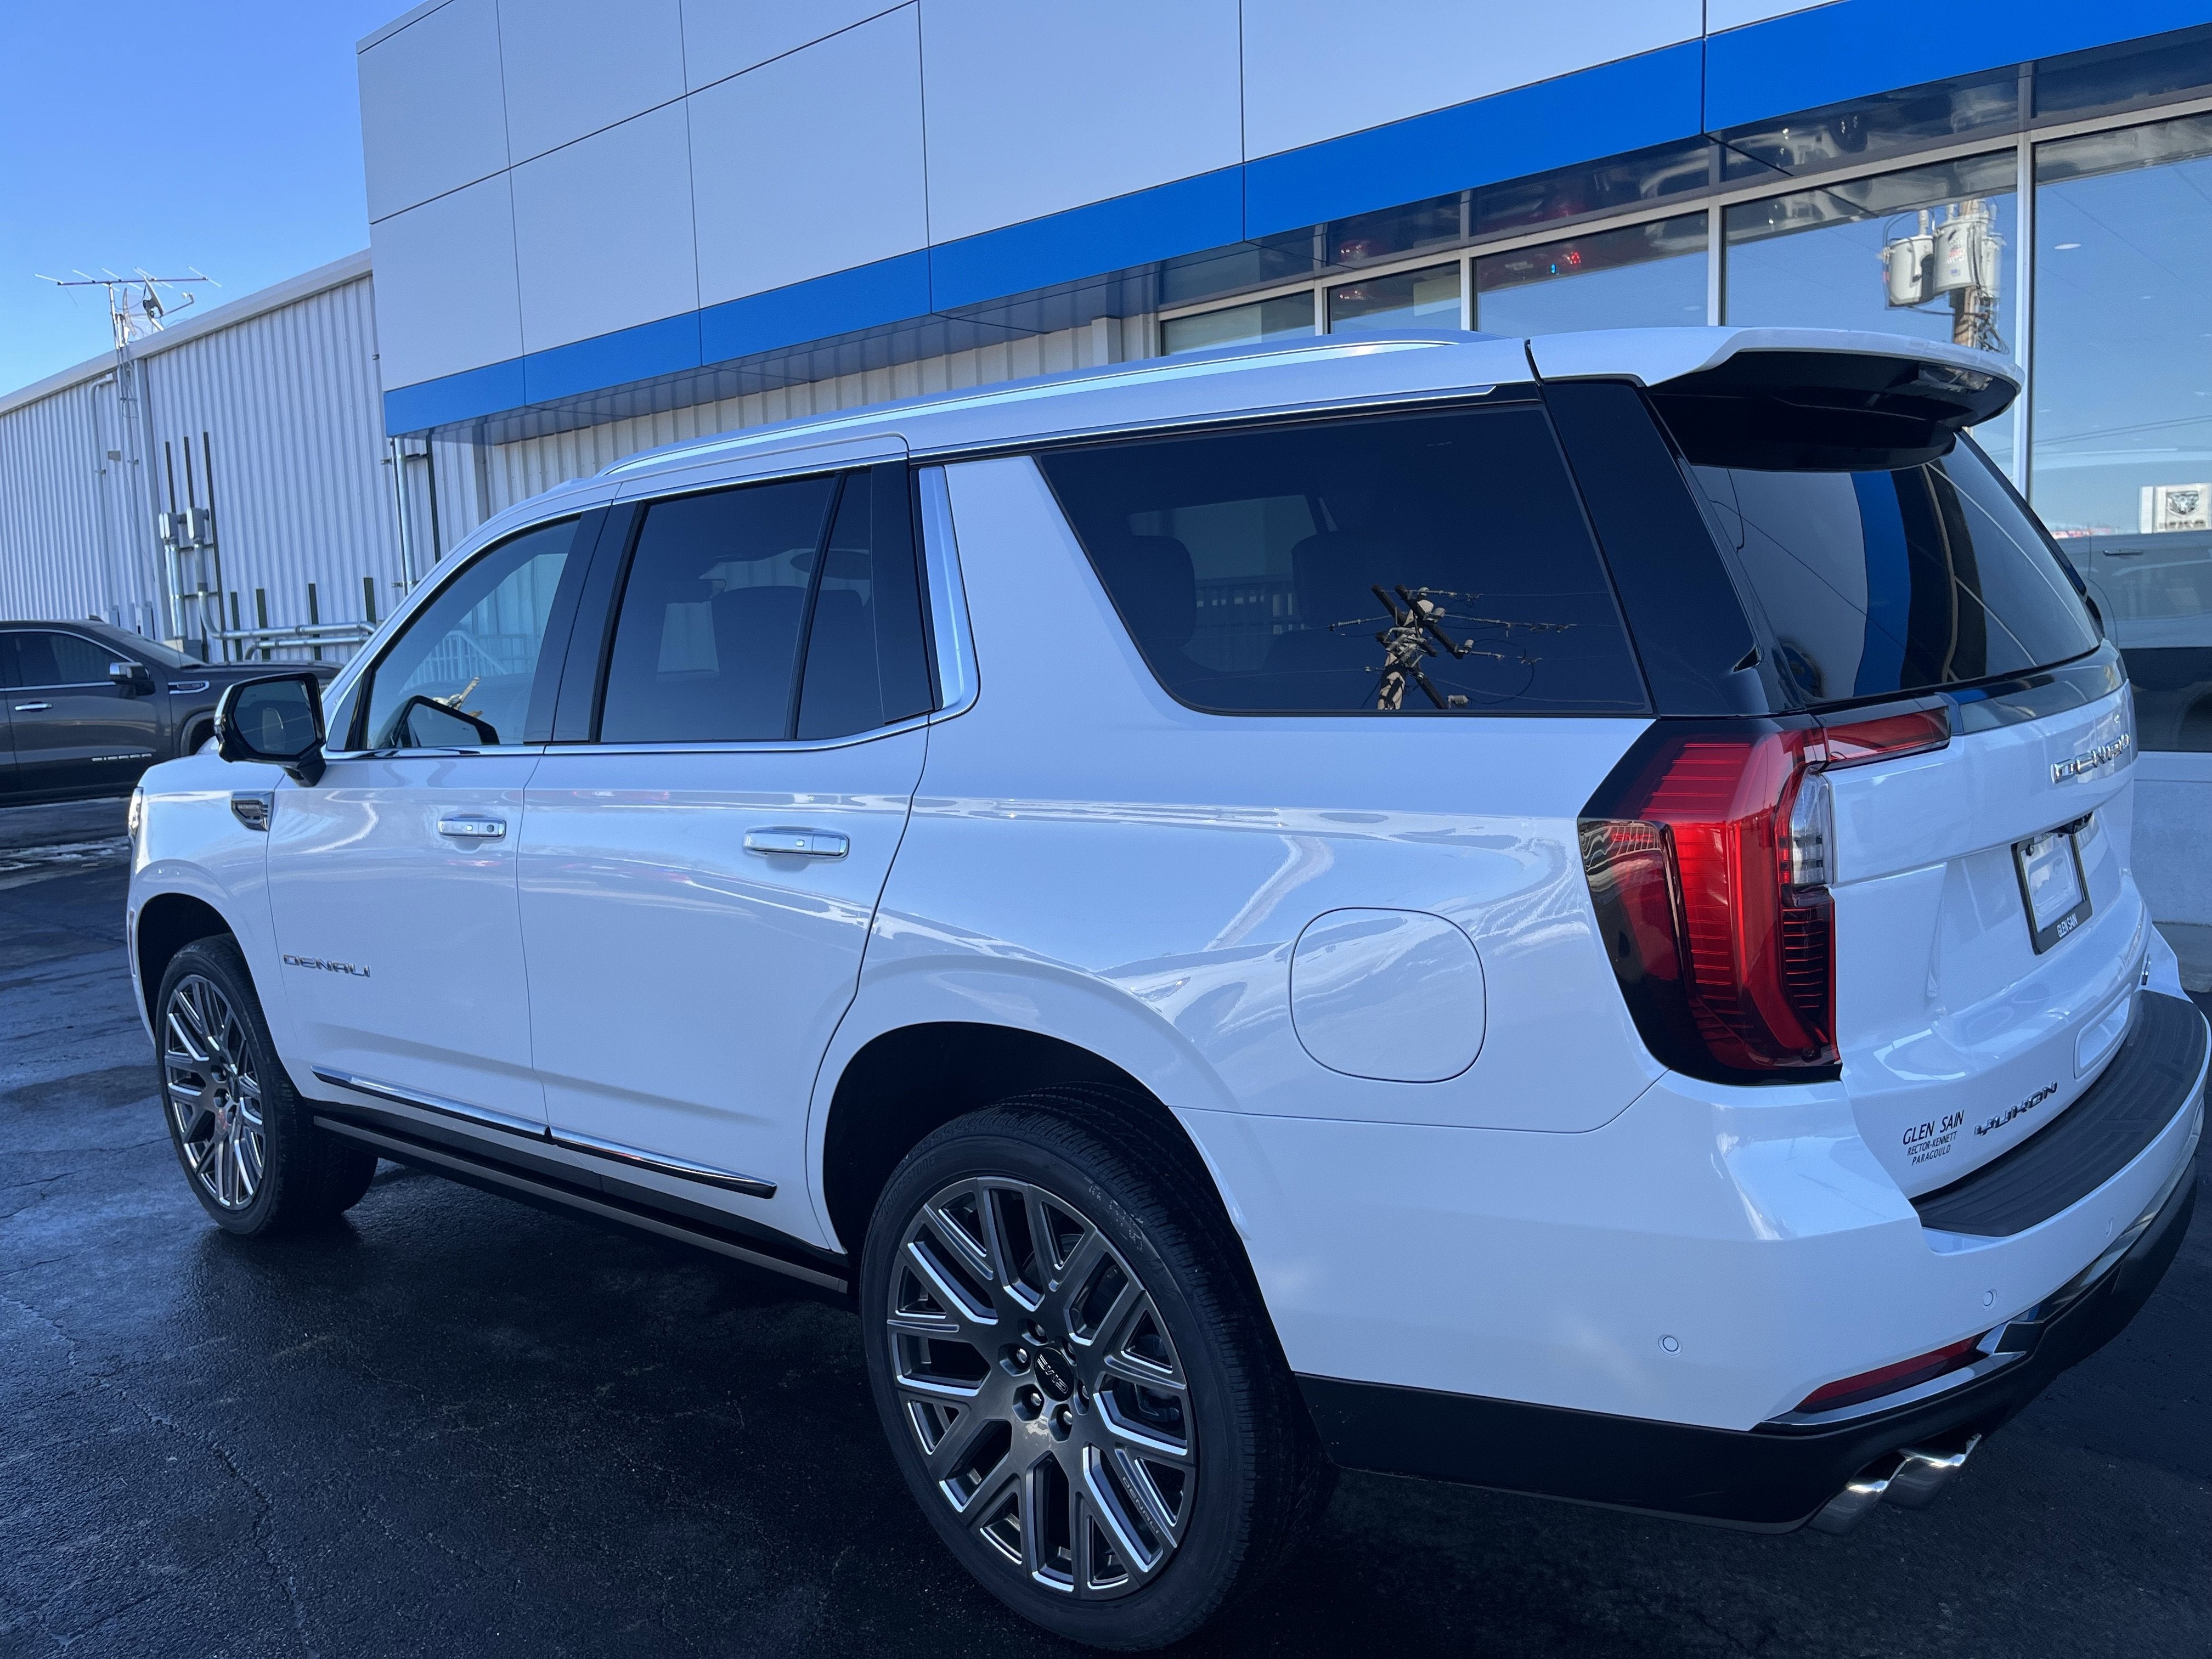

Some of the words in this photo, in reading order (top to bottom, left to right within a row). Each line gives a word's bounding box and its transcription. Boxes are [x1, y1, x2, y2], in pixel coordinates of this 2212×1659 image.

[1611, 833, 1654, 843] GMC
[283, 954, 370, 978] DENALI
[1974, 1080, 2058, 1136] YUKON
[1903, 1120, 1936, 1145] GLEN
[1939, 1109, 1965, 1133] SAIN
[1907, 1130, 1958, 1156] RECTOR-KENNETT
[1911, 1144, 1951, 1166] PARAGOULD
[1037, 1353, 1069, 1394] GMC
[1122, 1476, 1159, 1534] DENALI
